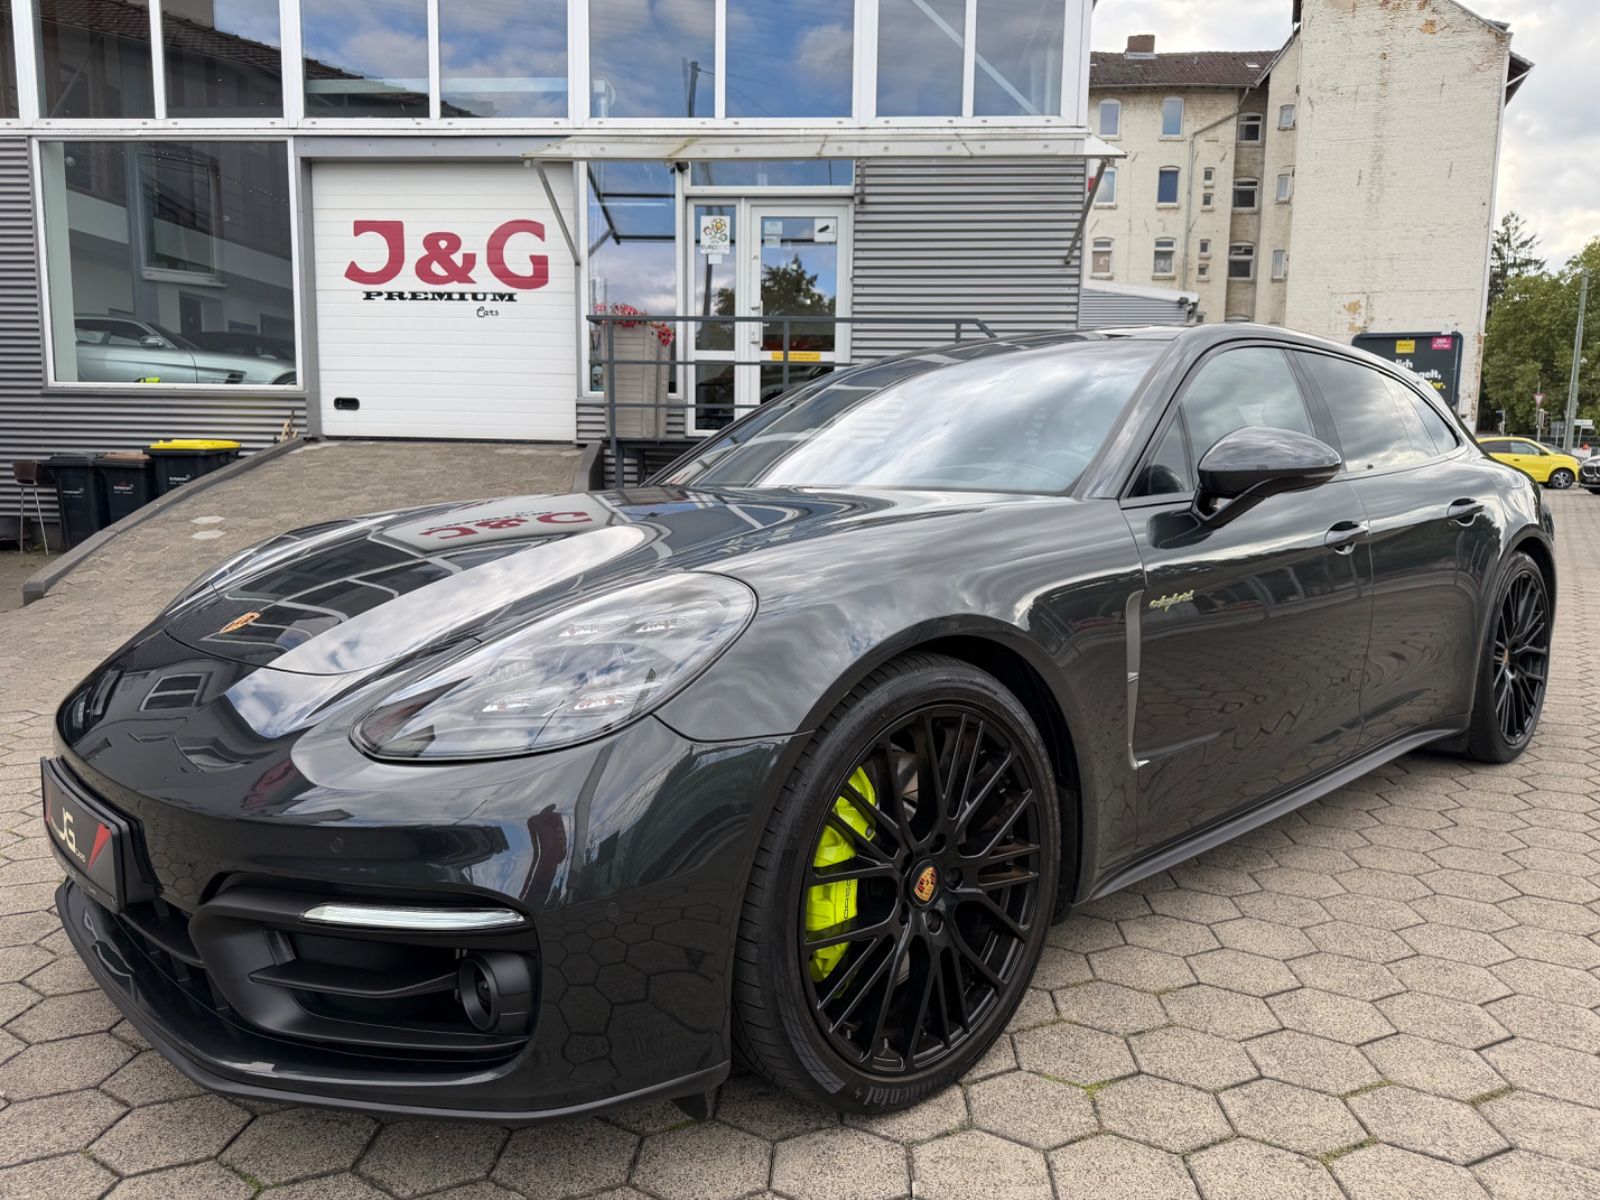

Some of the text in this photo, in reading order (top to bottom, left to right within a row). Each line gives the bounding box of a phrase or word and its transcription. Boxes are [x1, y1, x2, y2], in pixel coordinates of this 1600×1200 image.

[344, 219, 549, 290] J&G
[362, 291, 517, 302] PREMIUM
[476, 306, 500, 318] Cars
